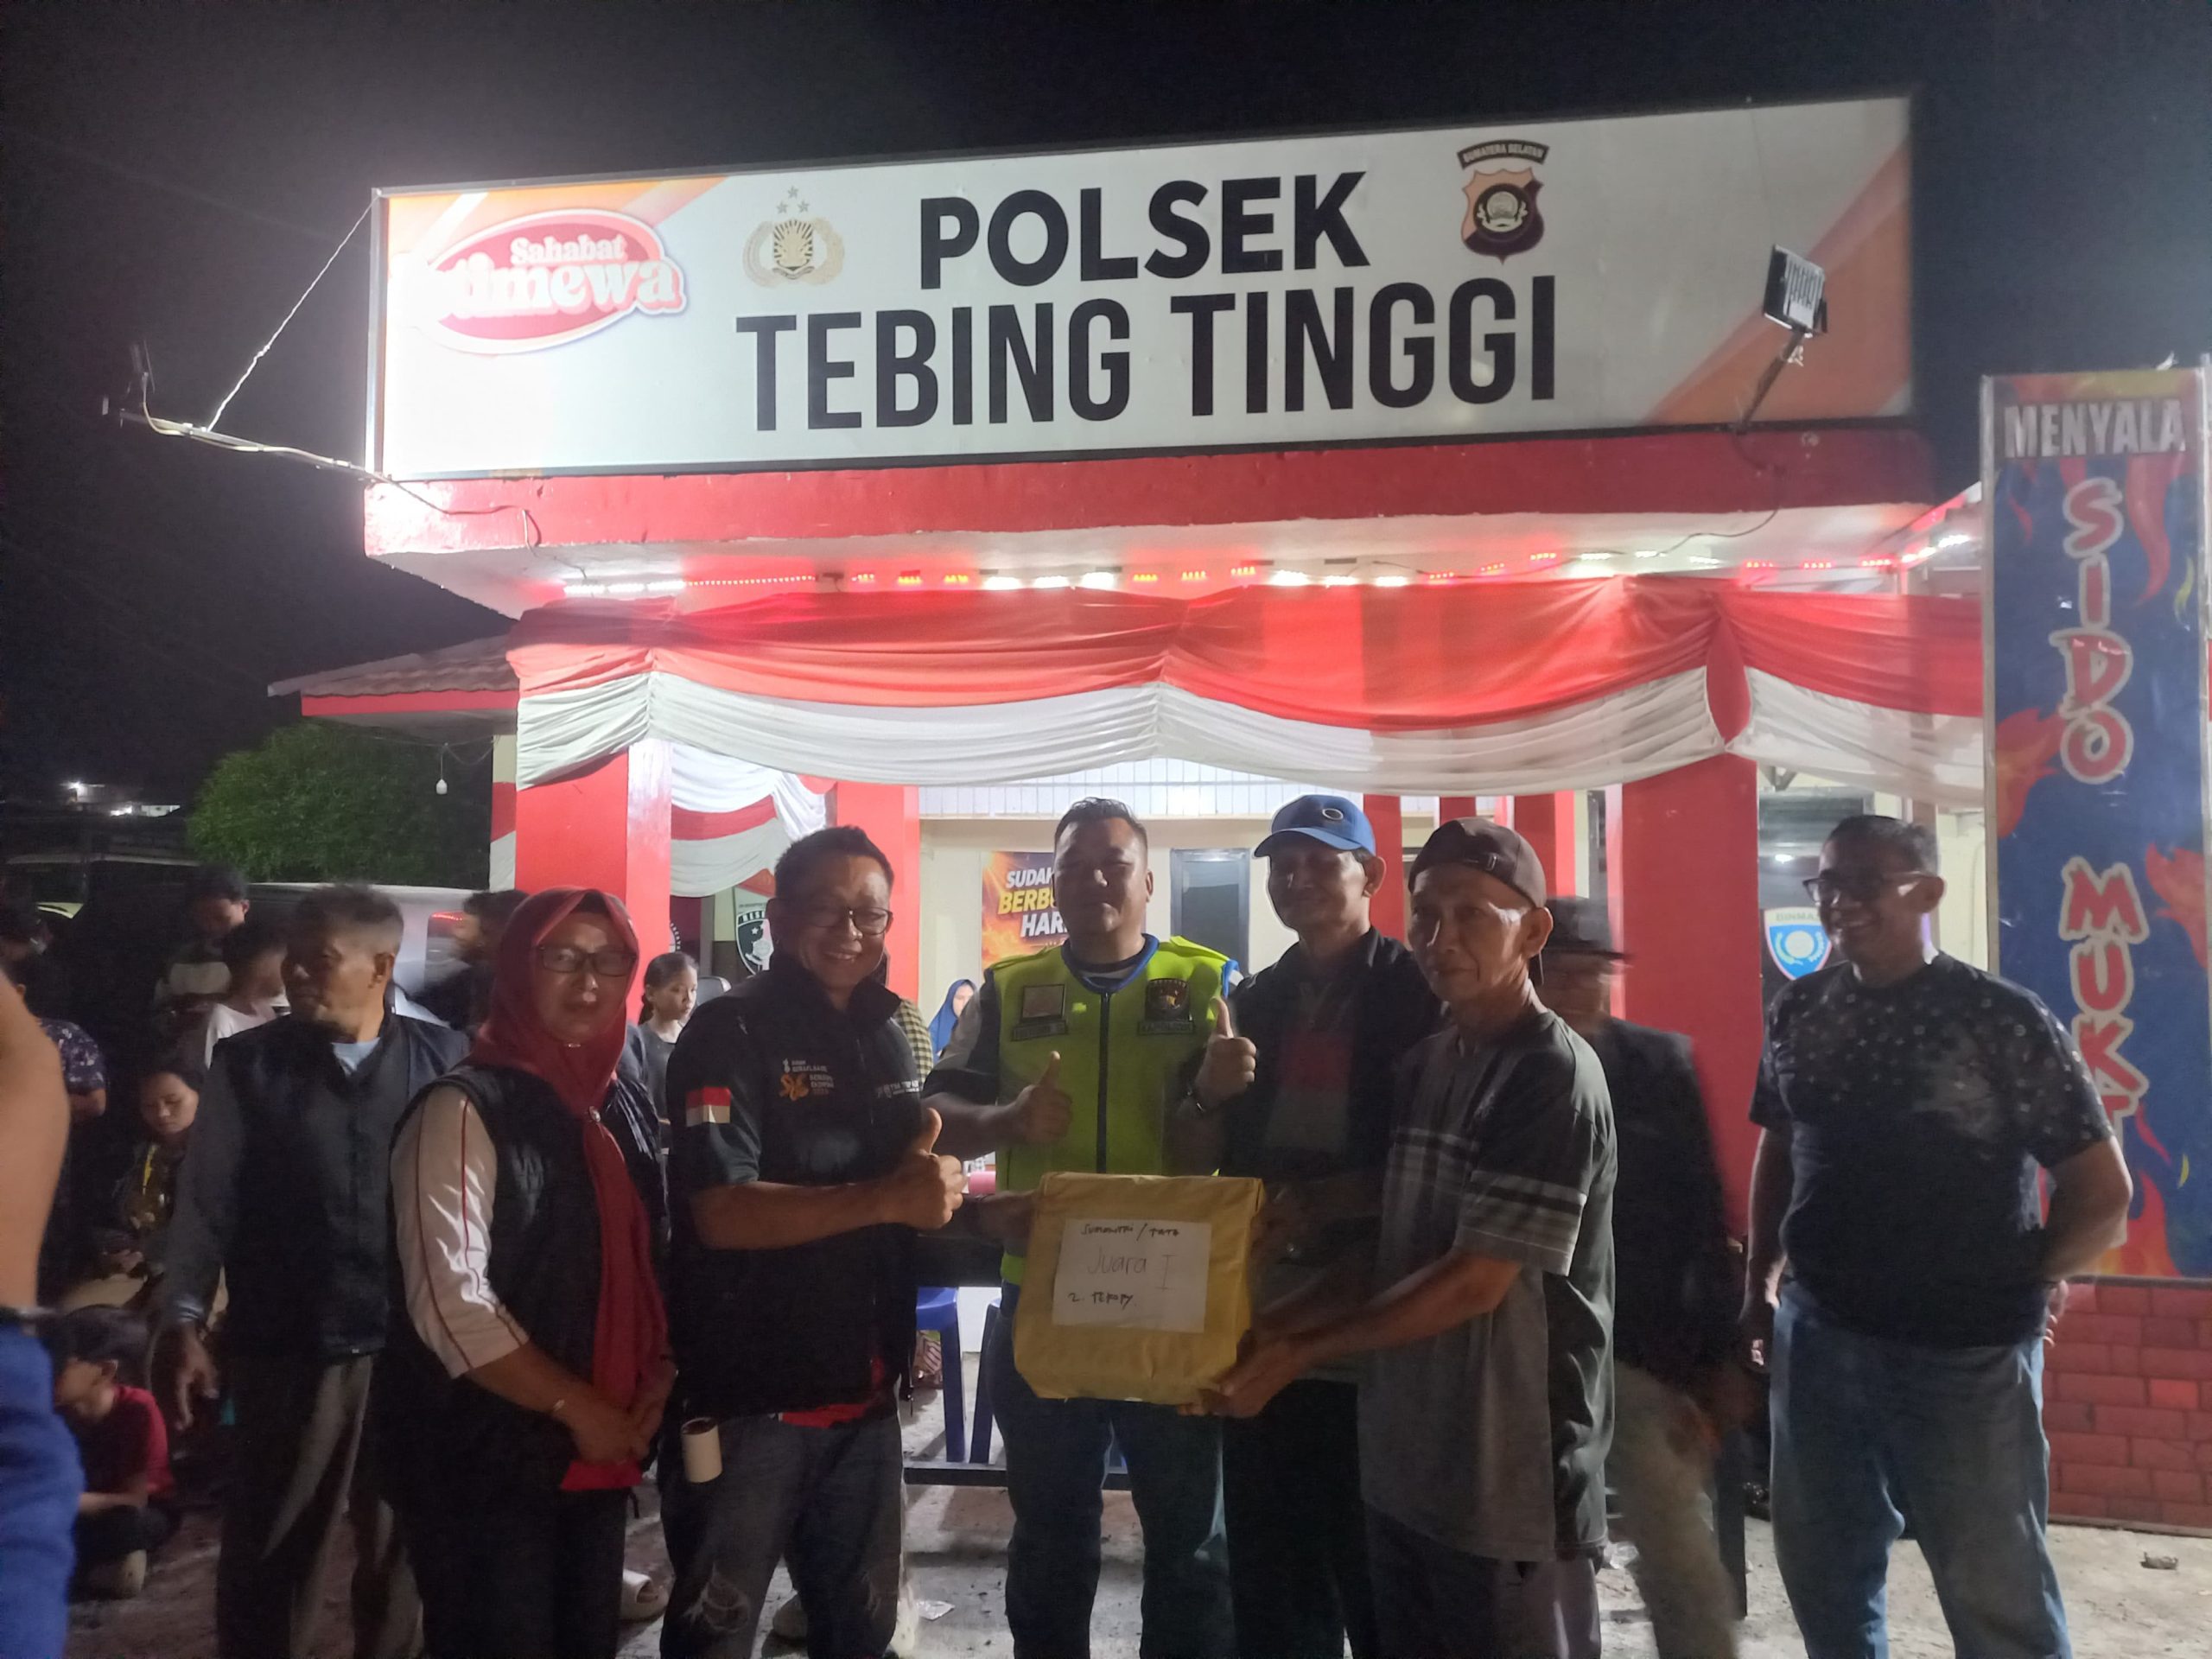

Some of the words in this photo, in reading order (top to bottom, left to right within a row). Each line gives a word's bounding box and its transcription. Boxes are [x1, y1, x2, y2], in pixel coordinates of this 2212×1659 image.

[510, 232, 627, 264] Sahabat
[920, 170, 1370, 290] POLSEK
[735, 297, 1131, 432] TEBING
[1170, 275, 1555, 418] TINGGI
[2003, 397, 2187, 460] MENYALA
[2048, 475, 2134, 785] SIDO
[2058, 855, 2151, 1123] MUK
[1086, 1247, 1147, 1275] Juara
